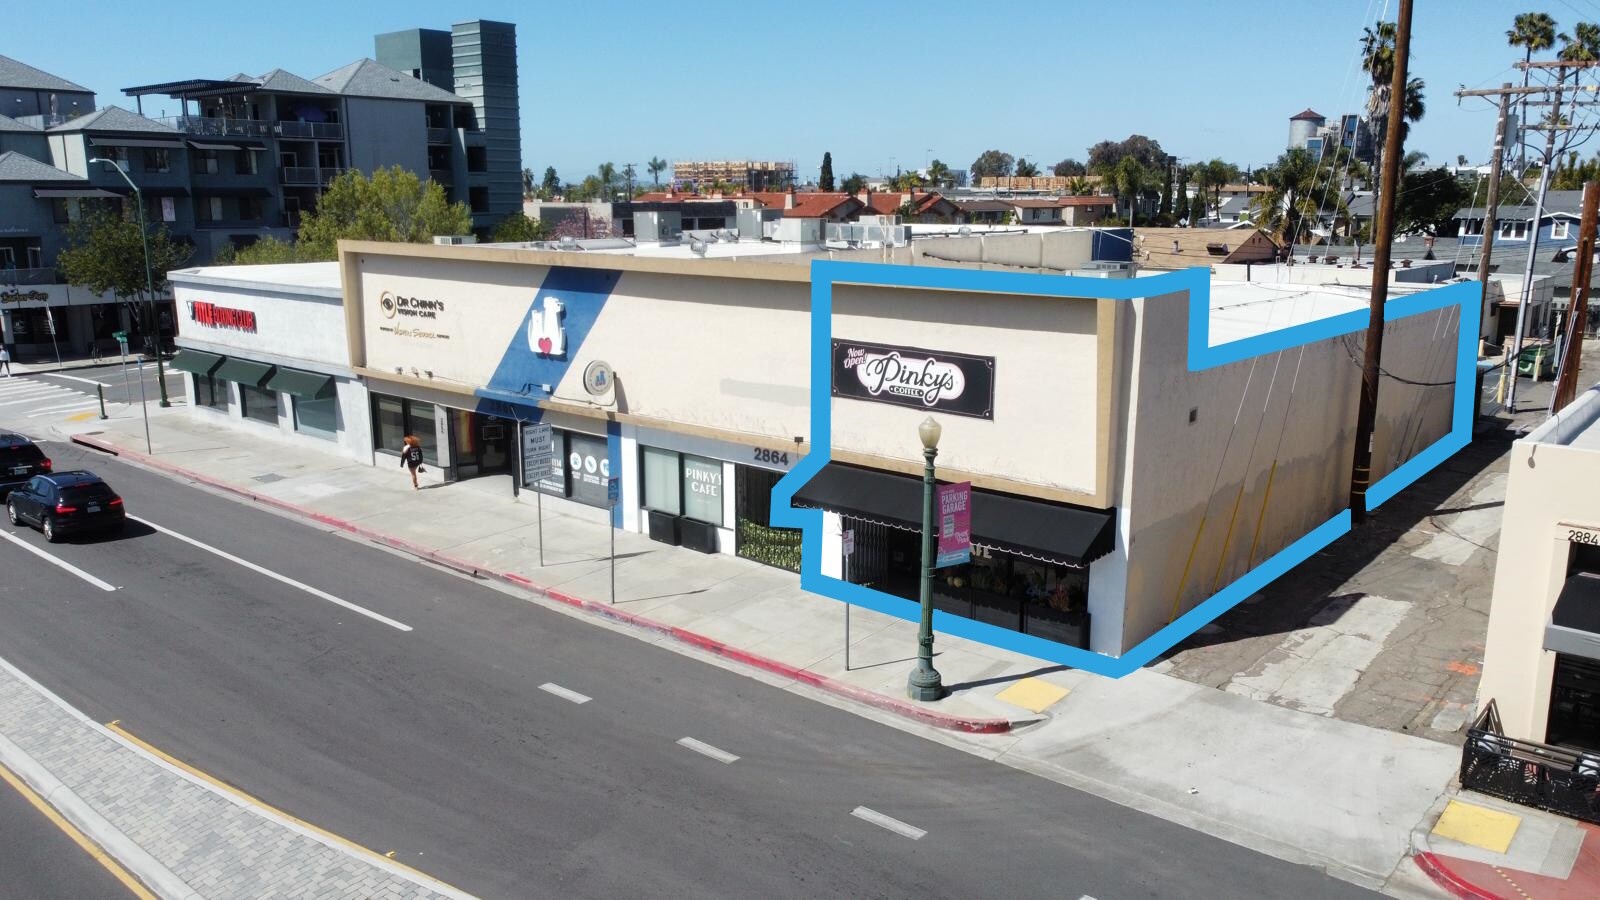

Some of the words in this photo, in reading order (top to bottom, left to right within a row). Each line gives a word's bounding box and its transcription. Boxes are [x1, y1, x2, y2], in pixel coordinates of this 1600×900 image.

[847, 348, 865, 358] Now
[843, 352, 869, 369] Open!
[866, 353, 954, 402] Pinky's
[893, 385, 921, 397] COFFEE
[530, 436, 545, 444] MUST
[754, 447, 788, 465] 2864
[691, 482, 718, 497] CAFE
[941, 490, 968, 504] PARKING
[943, 500, 966, 514] GARAGE
[1567, 529, 1598, 546] 2884
